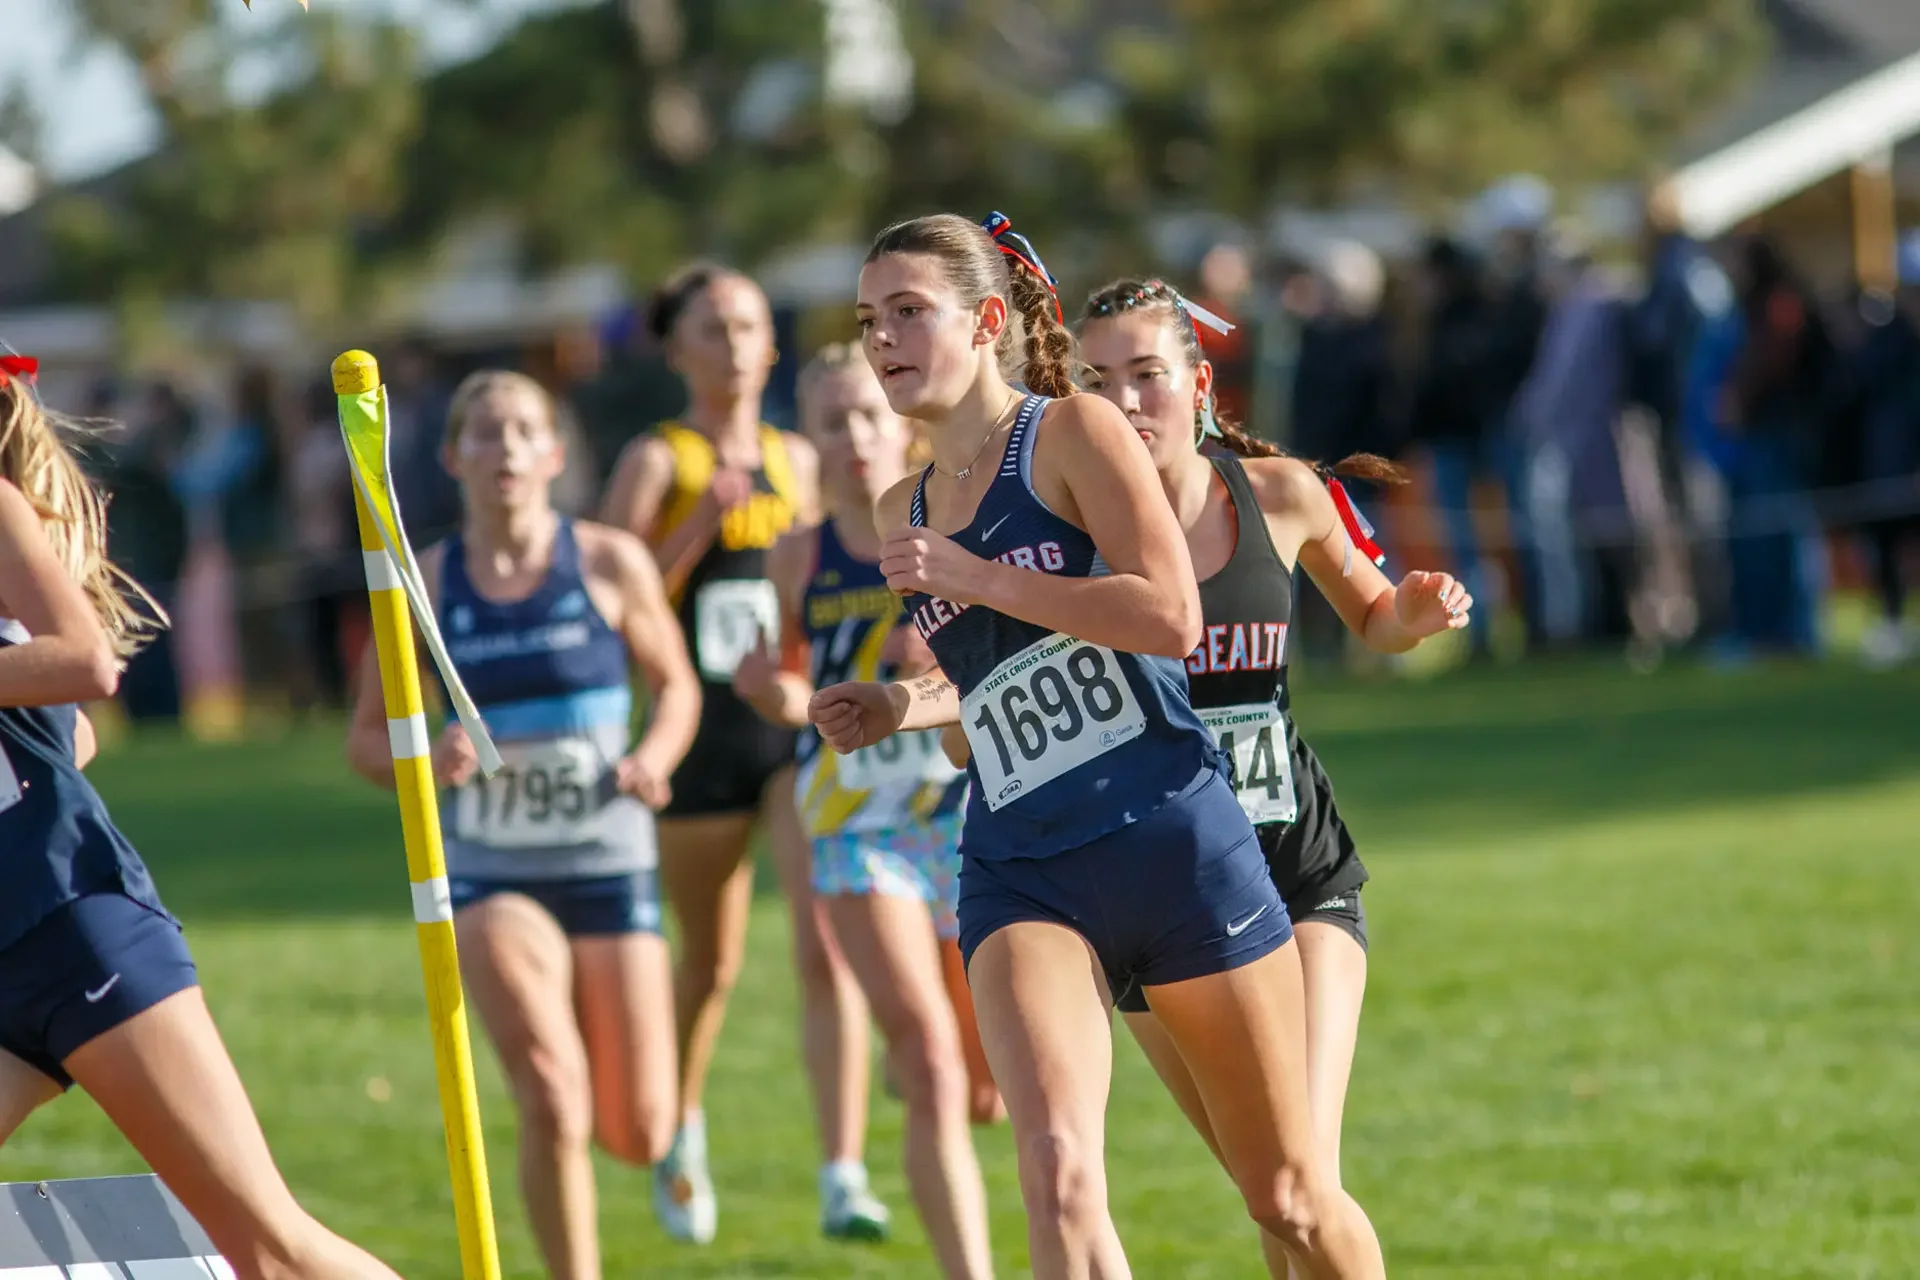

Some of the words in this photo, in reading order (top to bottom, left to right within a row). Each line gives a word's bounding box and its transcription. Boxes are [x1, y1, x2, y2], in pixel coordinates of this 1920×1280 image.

[984, 672, 1010, 693] STATE
[1009, 654, 1039, 676] CROSS
[1040, 636, 1080, 659] COUNTR
[974, 646, 1123, 777] 1698
[1203, 718, 1223, 727] OSS
[1226, 711, 1270, 725] COUNTRY
[475, 764, 586, 828] 1795
